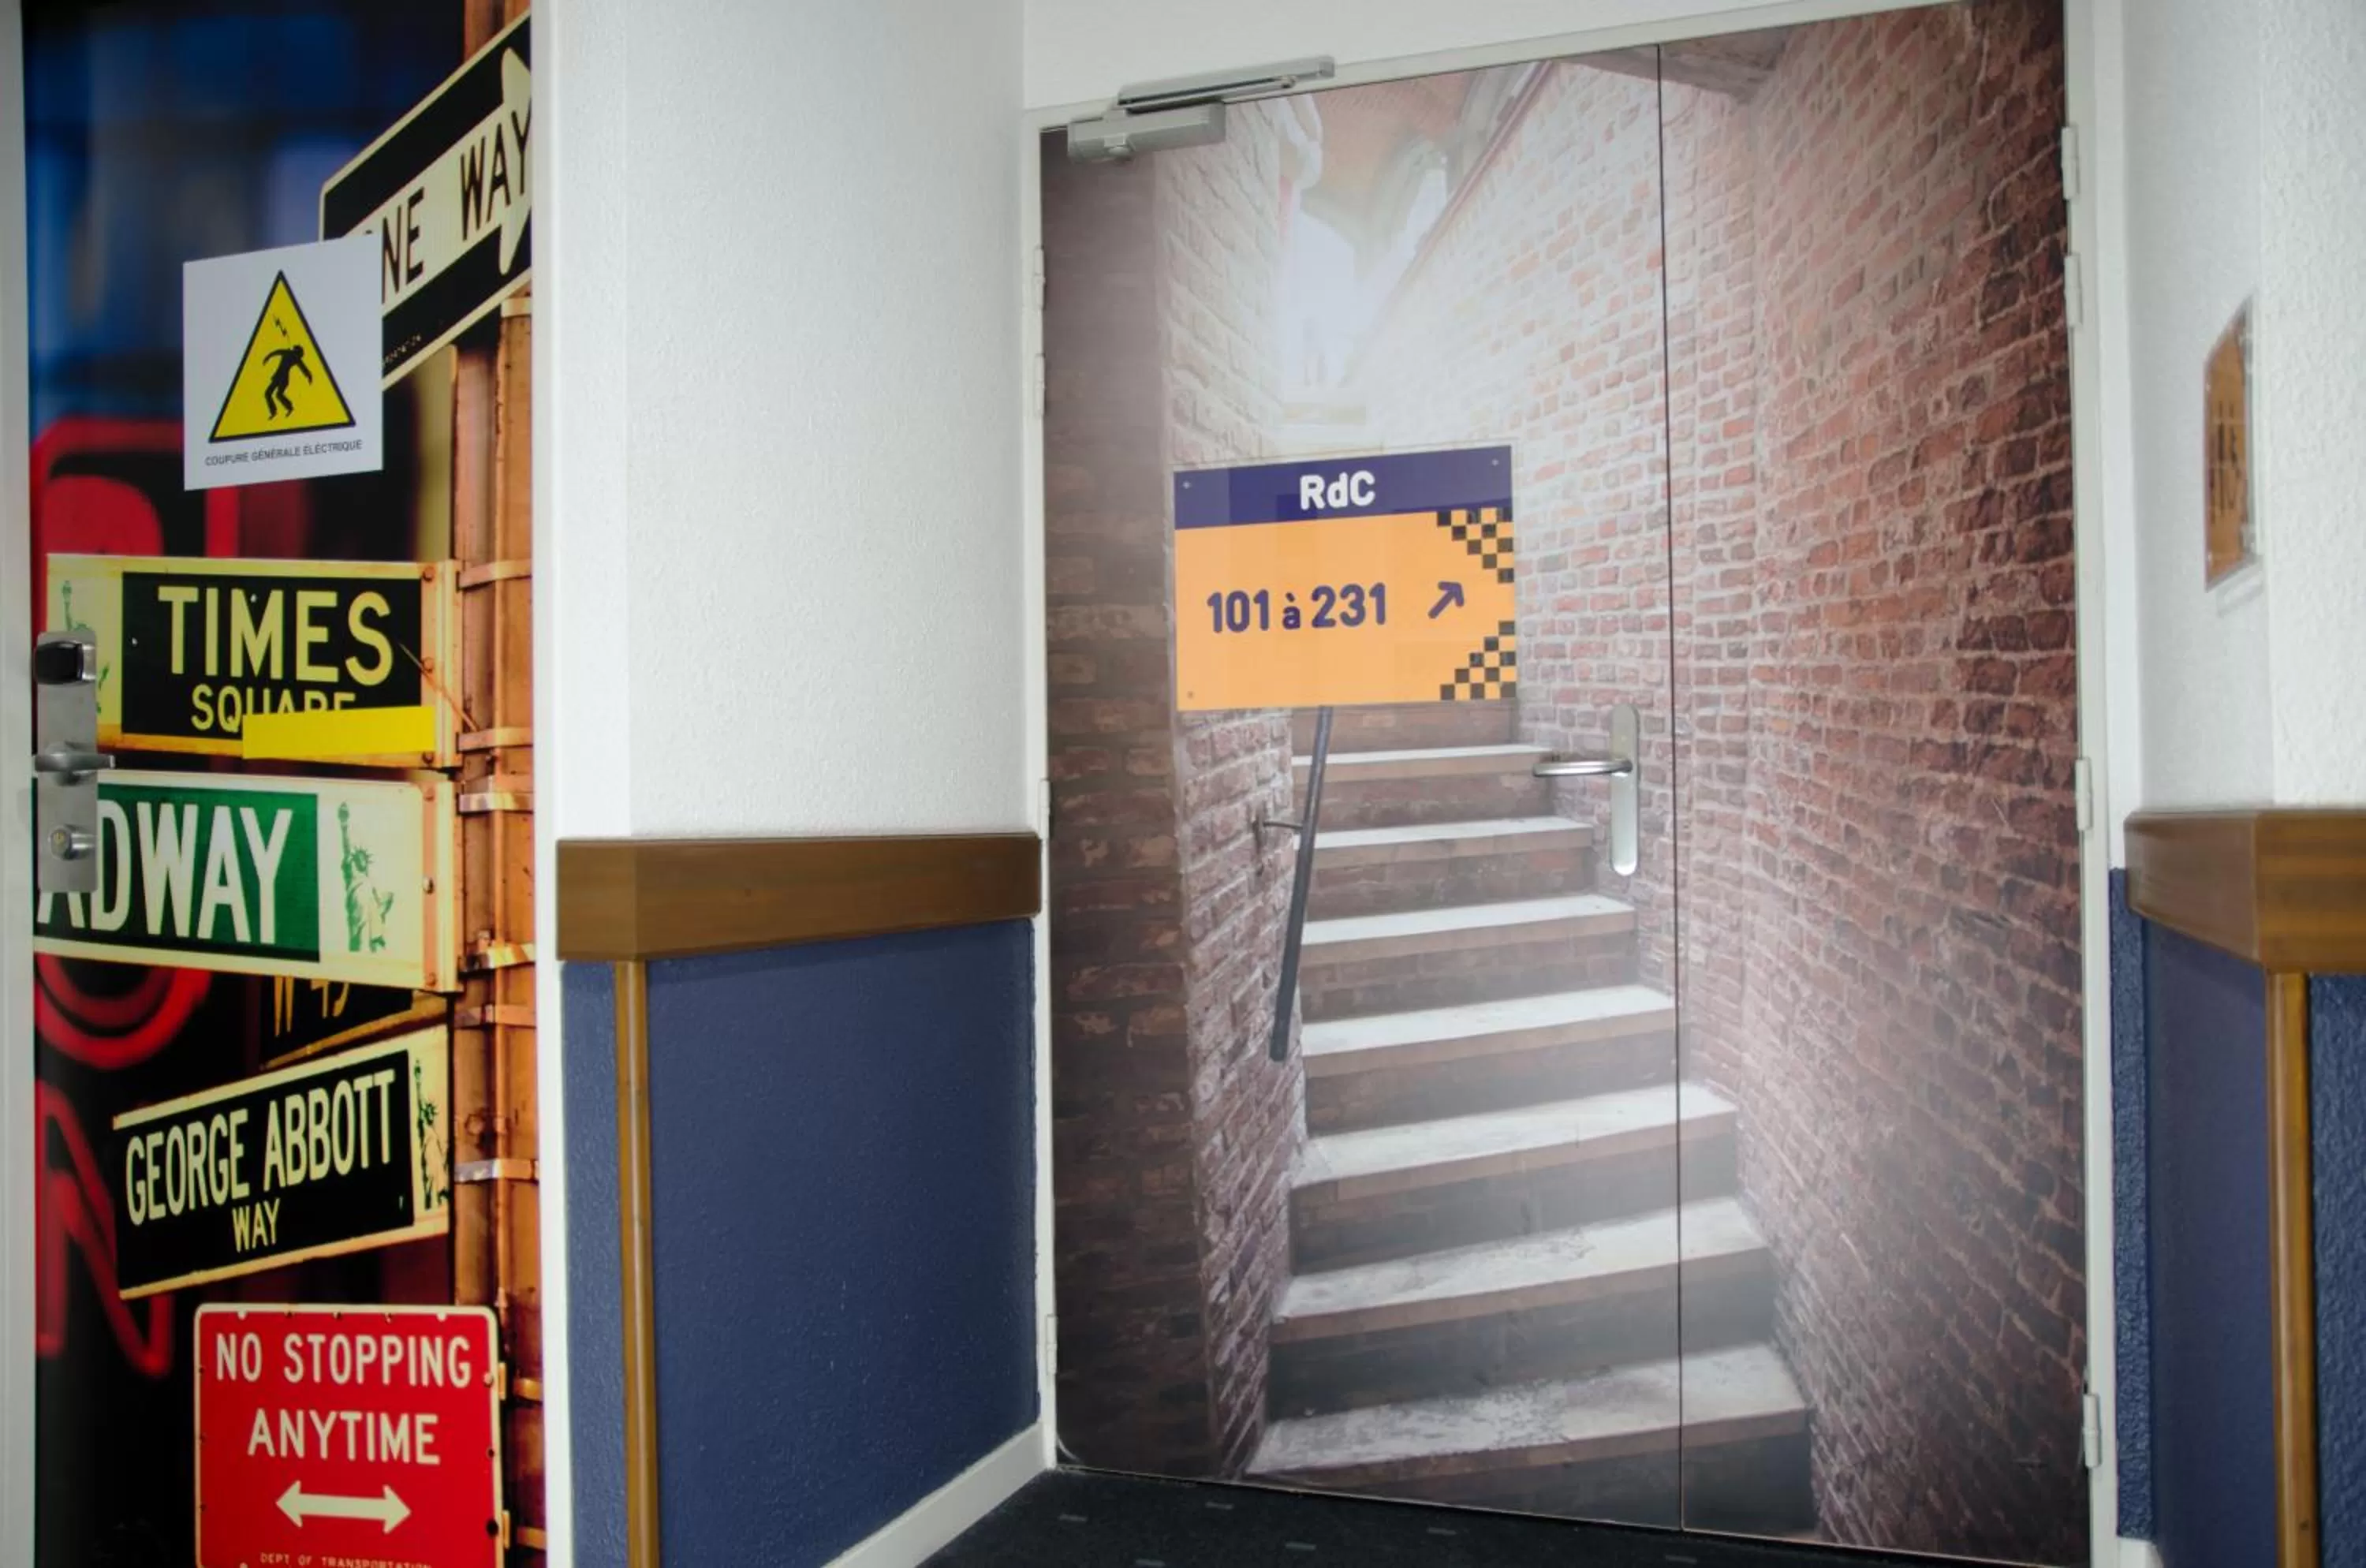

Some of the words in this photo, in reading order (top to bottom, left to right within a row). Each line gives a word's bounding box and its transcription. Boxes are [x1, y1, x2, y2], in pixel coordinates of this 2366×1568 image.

[364, 186, 424, 304] NE
[461, 99, 532, 241] WAY
[204, 452, 250, 466] COUPURE
[1300, 471, 1375, 510] RdC
[159, 586, 394, 686] TIMES
[1207, 589, 1270, 633] 101
[1282, 593, 1301, 629] à
[1311, 583, 1386, 628] 231
[37, 799, 293, 944] DWAY
[125, 1108, 250, 1226] GEORGE
[263, 1068, 395, 1193] ABBOTT
[233, 1197, 281, 1253] WAY
[216, 1333, 263, 1383] NO
[284, 1333, 471, 1388] STOPPING
[248, 1408, 440, 1465] ANYTIME
[259, 1551, 289, 1564] DEPT
[298, 1554, 312, 1566] OF
